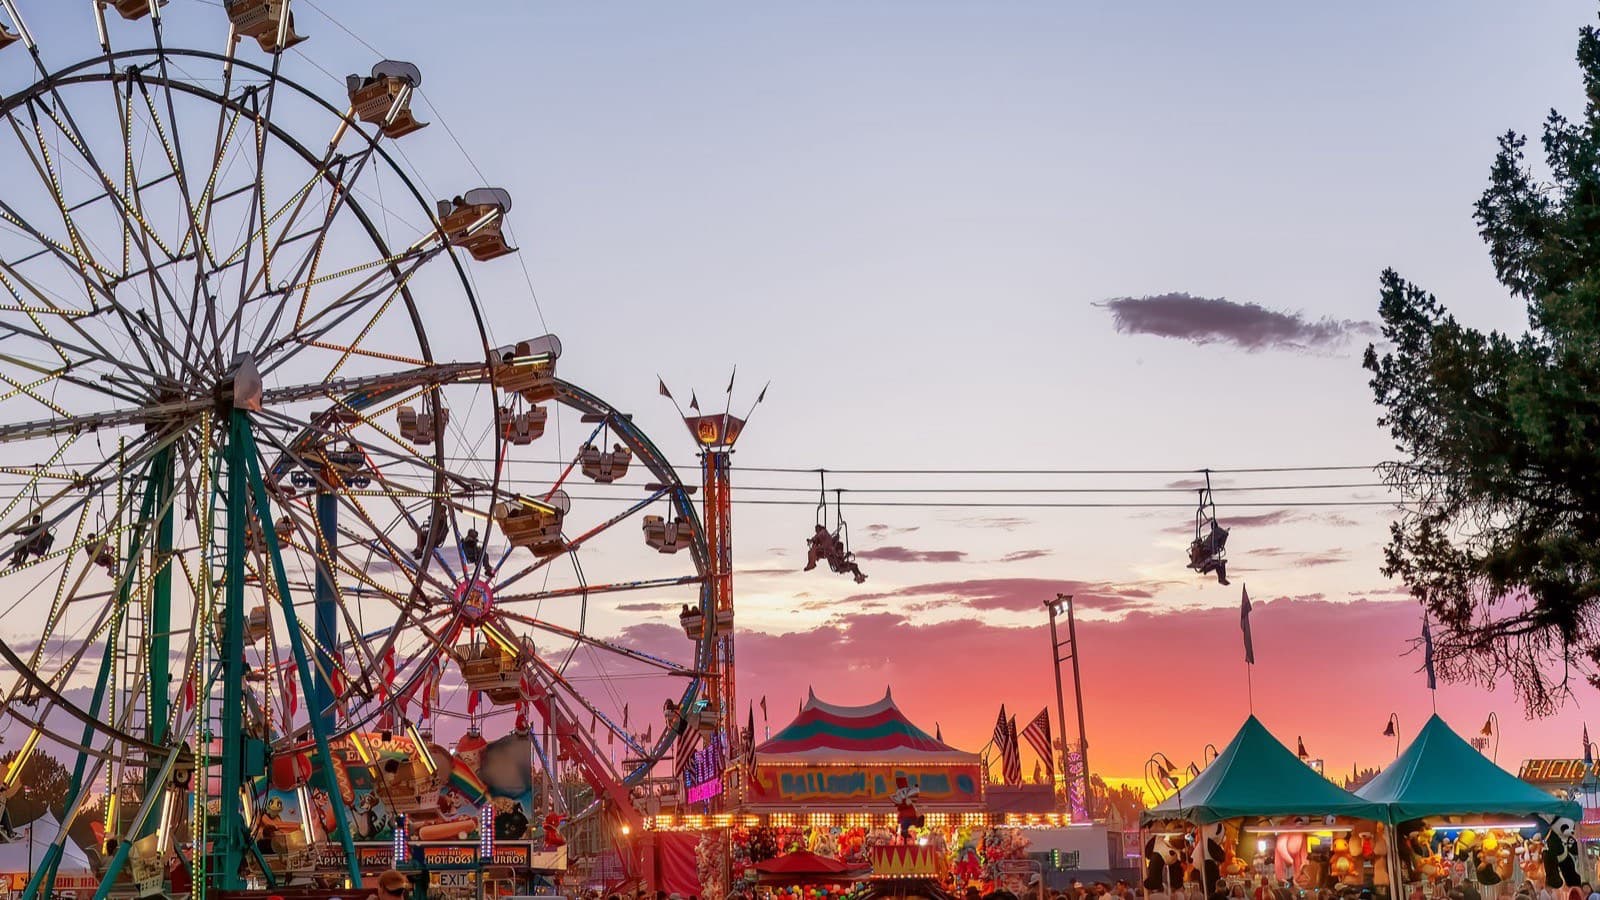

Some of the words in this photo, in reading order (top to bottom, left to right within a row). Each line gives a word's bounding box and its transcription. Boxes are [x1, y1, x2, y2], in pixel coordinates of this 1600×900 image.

[427, 855, 446, 865] HOT
[448, 855, 472, 865] DOGS
[493, 855, 524, 865] URROS
[440, 874, 467, 886] EXIT
